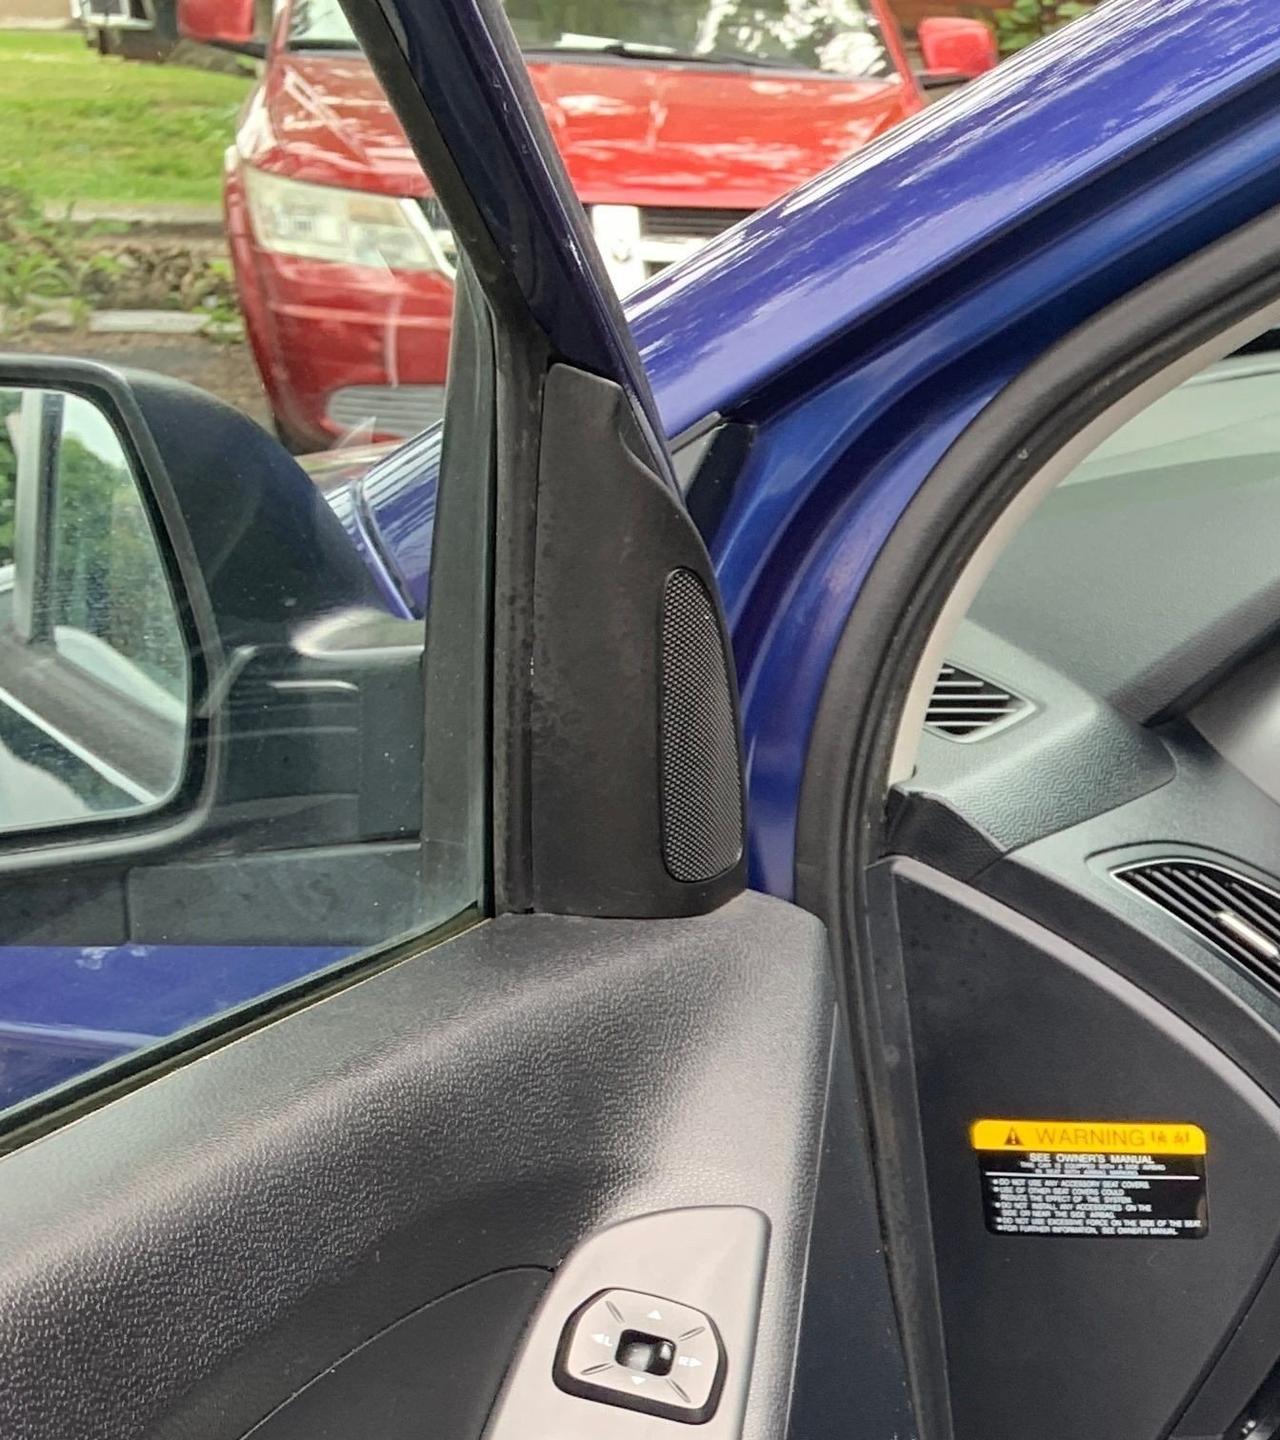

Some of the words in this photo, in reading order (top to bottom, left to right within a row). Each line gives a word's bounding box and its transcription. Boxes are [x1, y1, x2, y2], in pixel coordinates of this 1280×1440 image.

[1035, 1128, 1145, 1146] WARNING
[1028, 1152, 1051, 1163] SEE
[1056, 1153, 1106, 1164] OWNER'S
